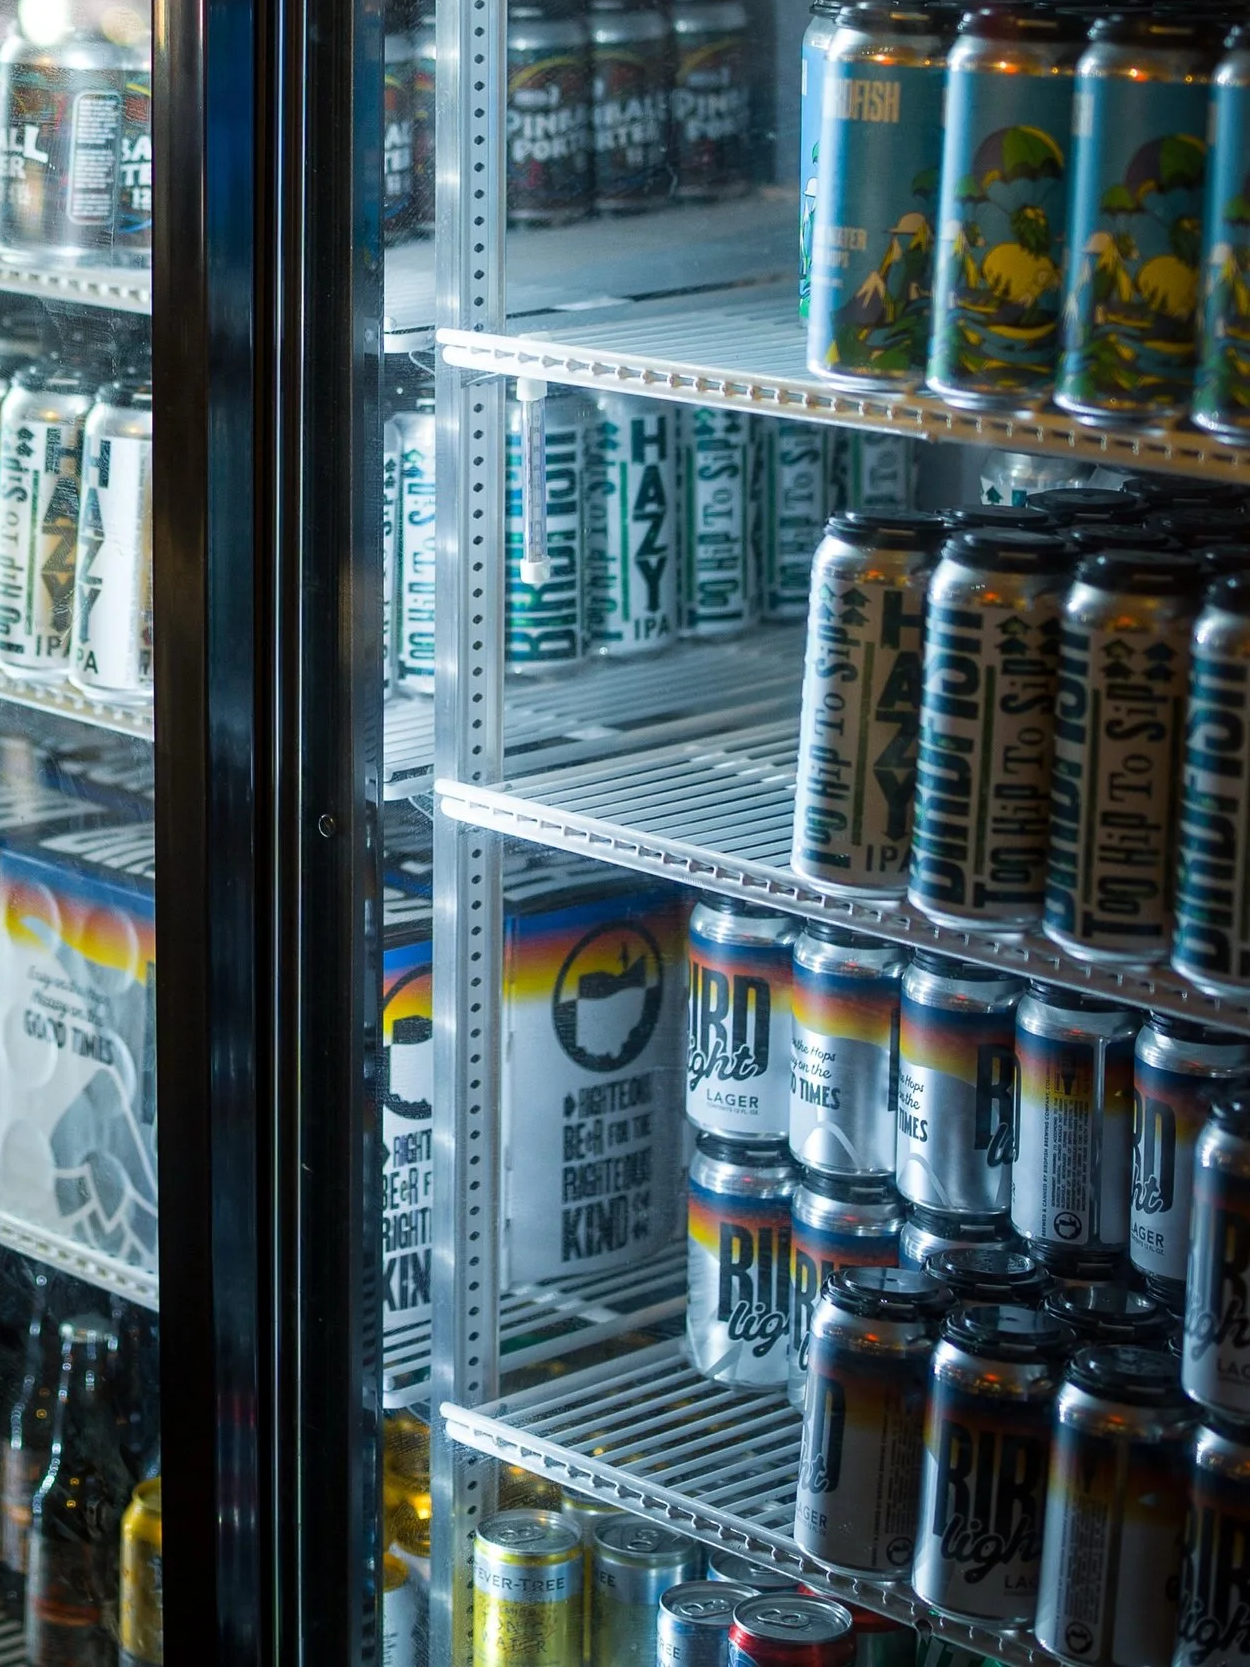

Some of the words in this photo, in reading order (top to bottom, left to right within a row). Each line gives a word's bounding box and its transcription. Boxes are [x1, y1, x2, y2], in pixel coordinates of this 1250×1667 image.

[41, 427, 81, 633] HAZY
[631, 416, 668, 613] HAZY
[634, 616, 670, 641] IPA
[873, 590, 926, 842] HAZY
[688, 958, 771, 1078] IRD
[71, 1025, 115, 1066] TIMES
[810, 1045, 837, 1064] Hops
[810, 1062, 832, 1080] the
[904, 1075, 925, 1094] Hops
[706, 1088, 760, 1110] LAGER
[799, 1077, 842, 1111] TIMES
[562, 1194, 629, 1263] KIND
[727, 1300, 790, 1358] lig
[796, 1504, 829, 1530] AGER
